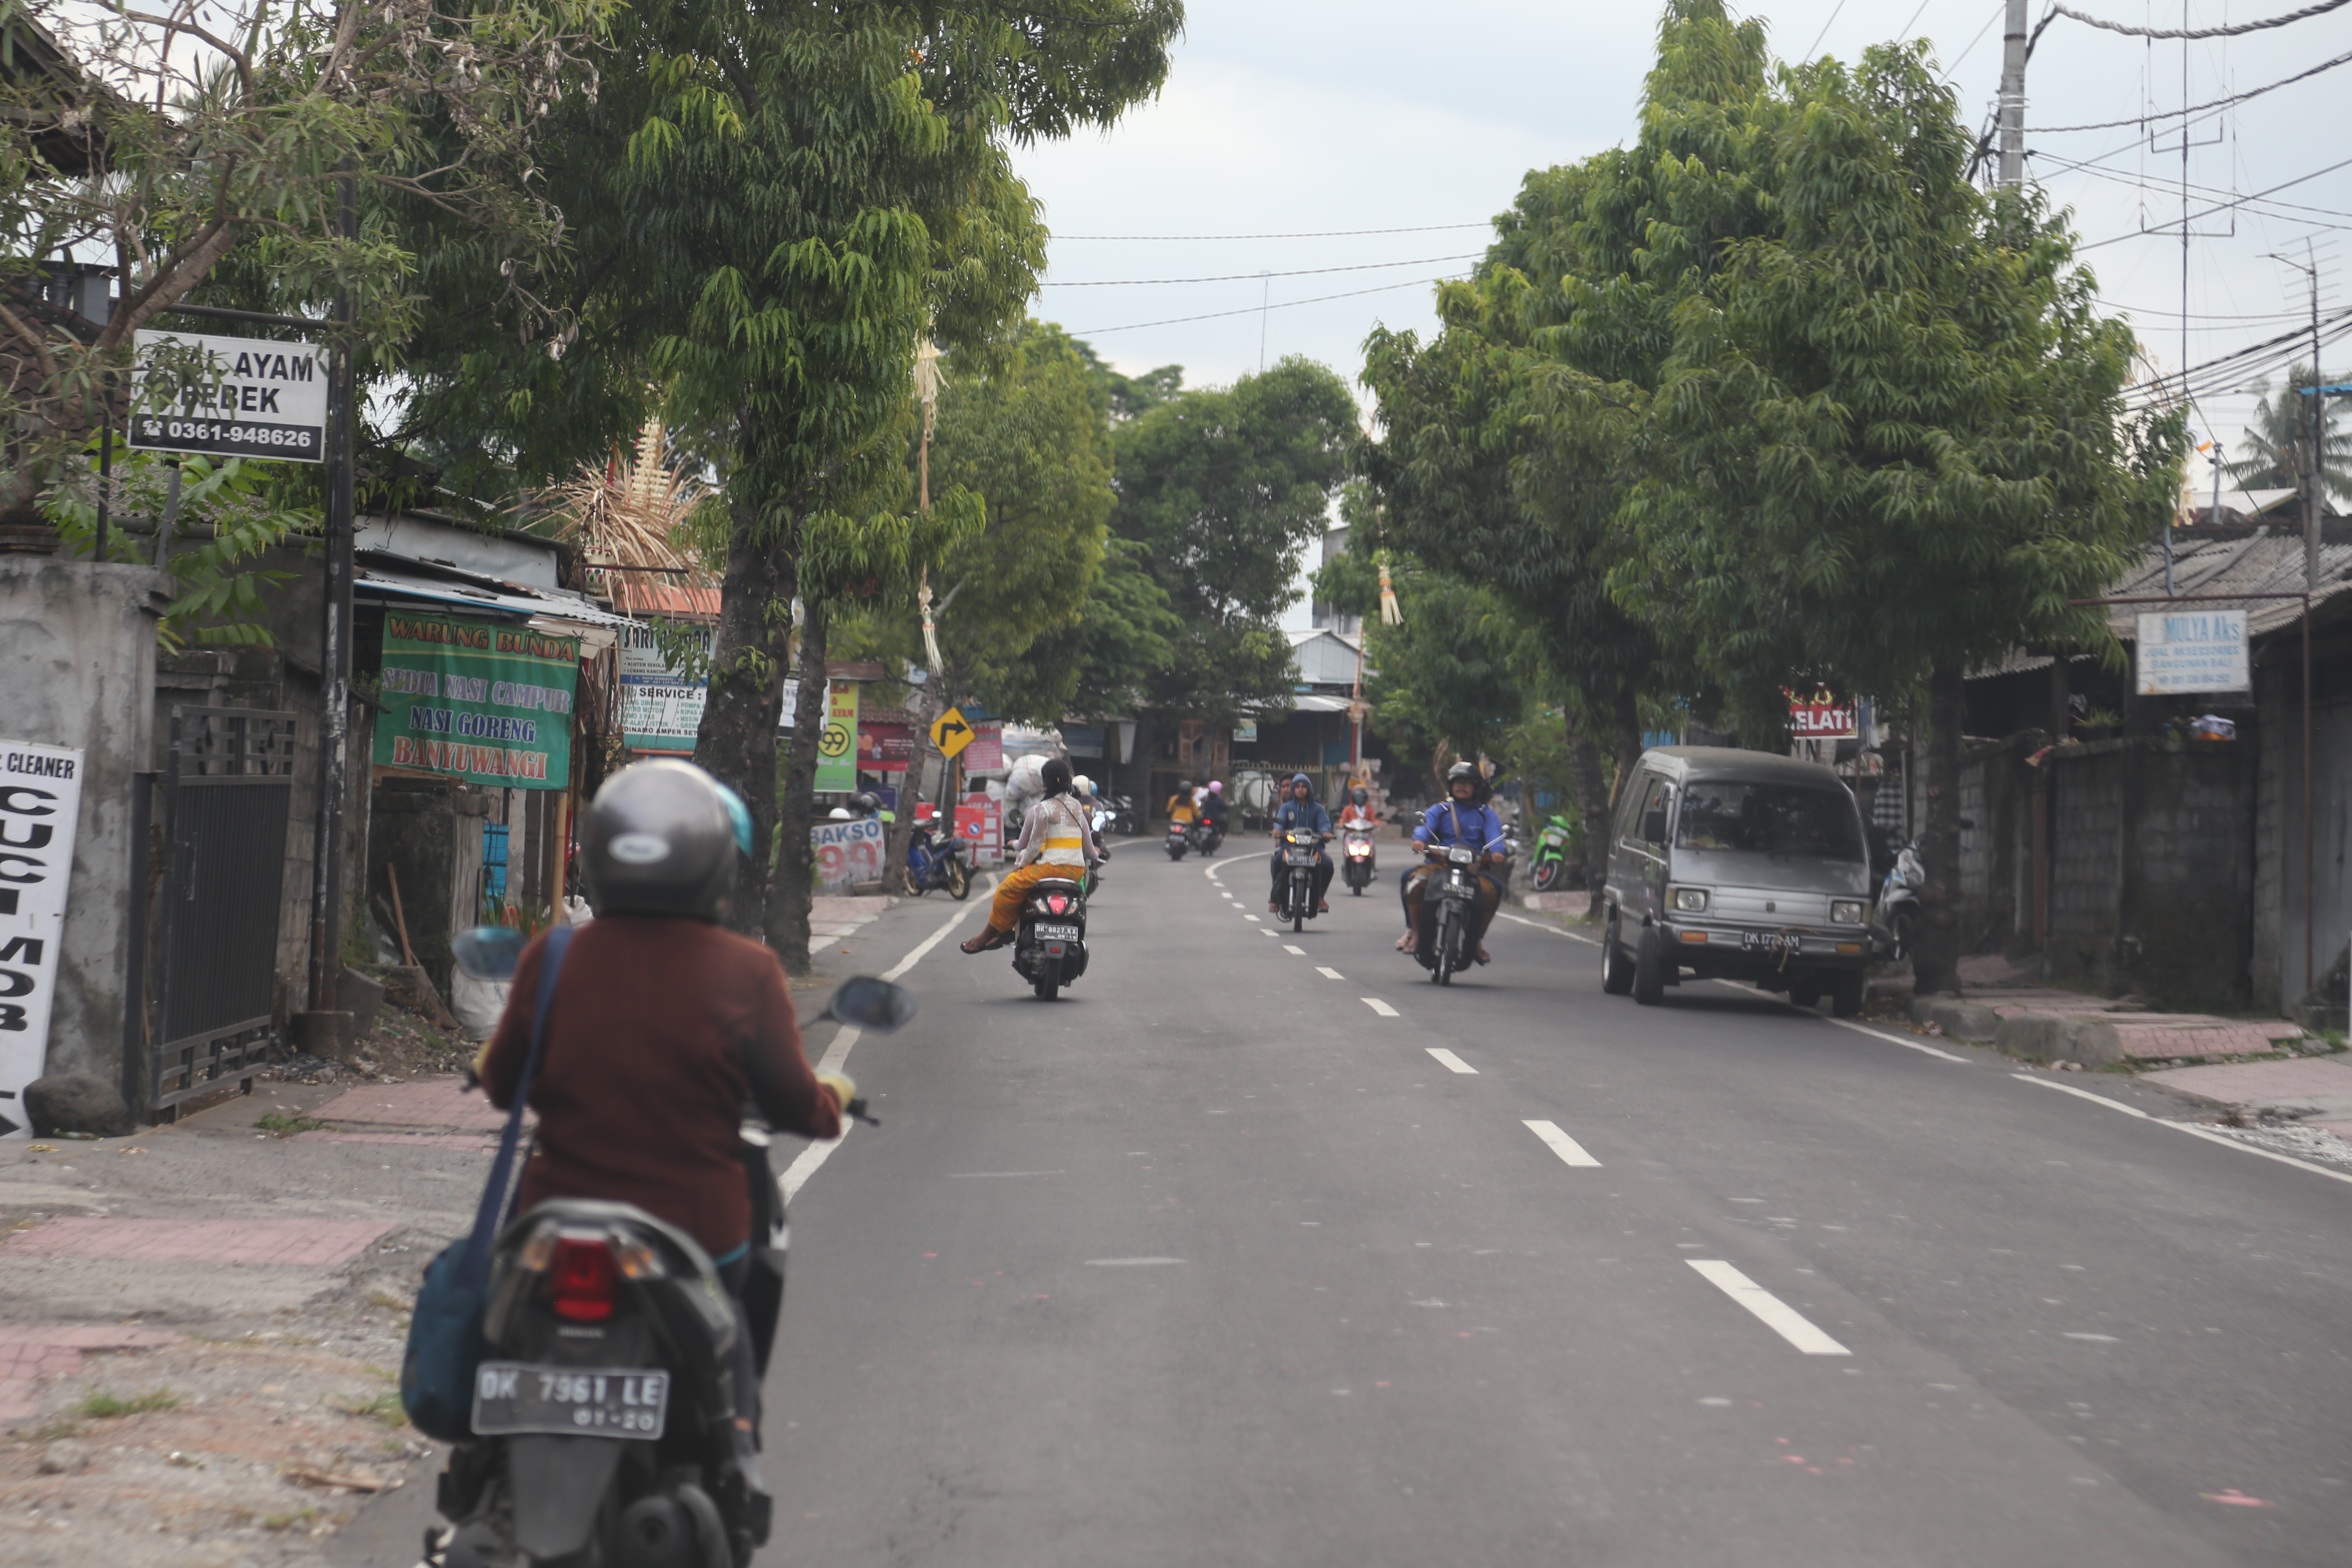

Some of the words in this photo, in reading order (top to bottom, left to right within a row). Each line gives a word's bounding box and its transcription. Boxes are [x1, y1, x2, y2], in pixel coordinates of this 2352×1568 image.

[233, 352, 313, 382] AYAM
[168, 422, 311, 447] 0361-948626
[389, 616, 490, 650] WARUNG
[495, 631, 575, 662] BUNDA
[2152, 658, 2208, 669] BANGUNAN
[2210, 658, 2232, 667] BALI
[382, 668, 438, 697] SEDIA
[443, 674, 489, 703] NASI
[492, 681, 571, 714] CAMPUR
[639, 687, 694, 700] SERVICE
[409, 706, 453, 732] NASI
[456, 712, 536, 743] GORENG
[823, 731, 845, 751] 99
[8, 752, 74, 779] CLEANER
[392, 736, 548, 779] BANYUWANGI
[1744, 932, 1759, 945] DK
[480, 1370, 519, 1400] DK
[622, 1376, 661, 1406] LE
